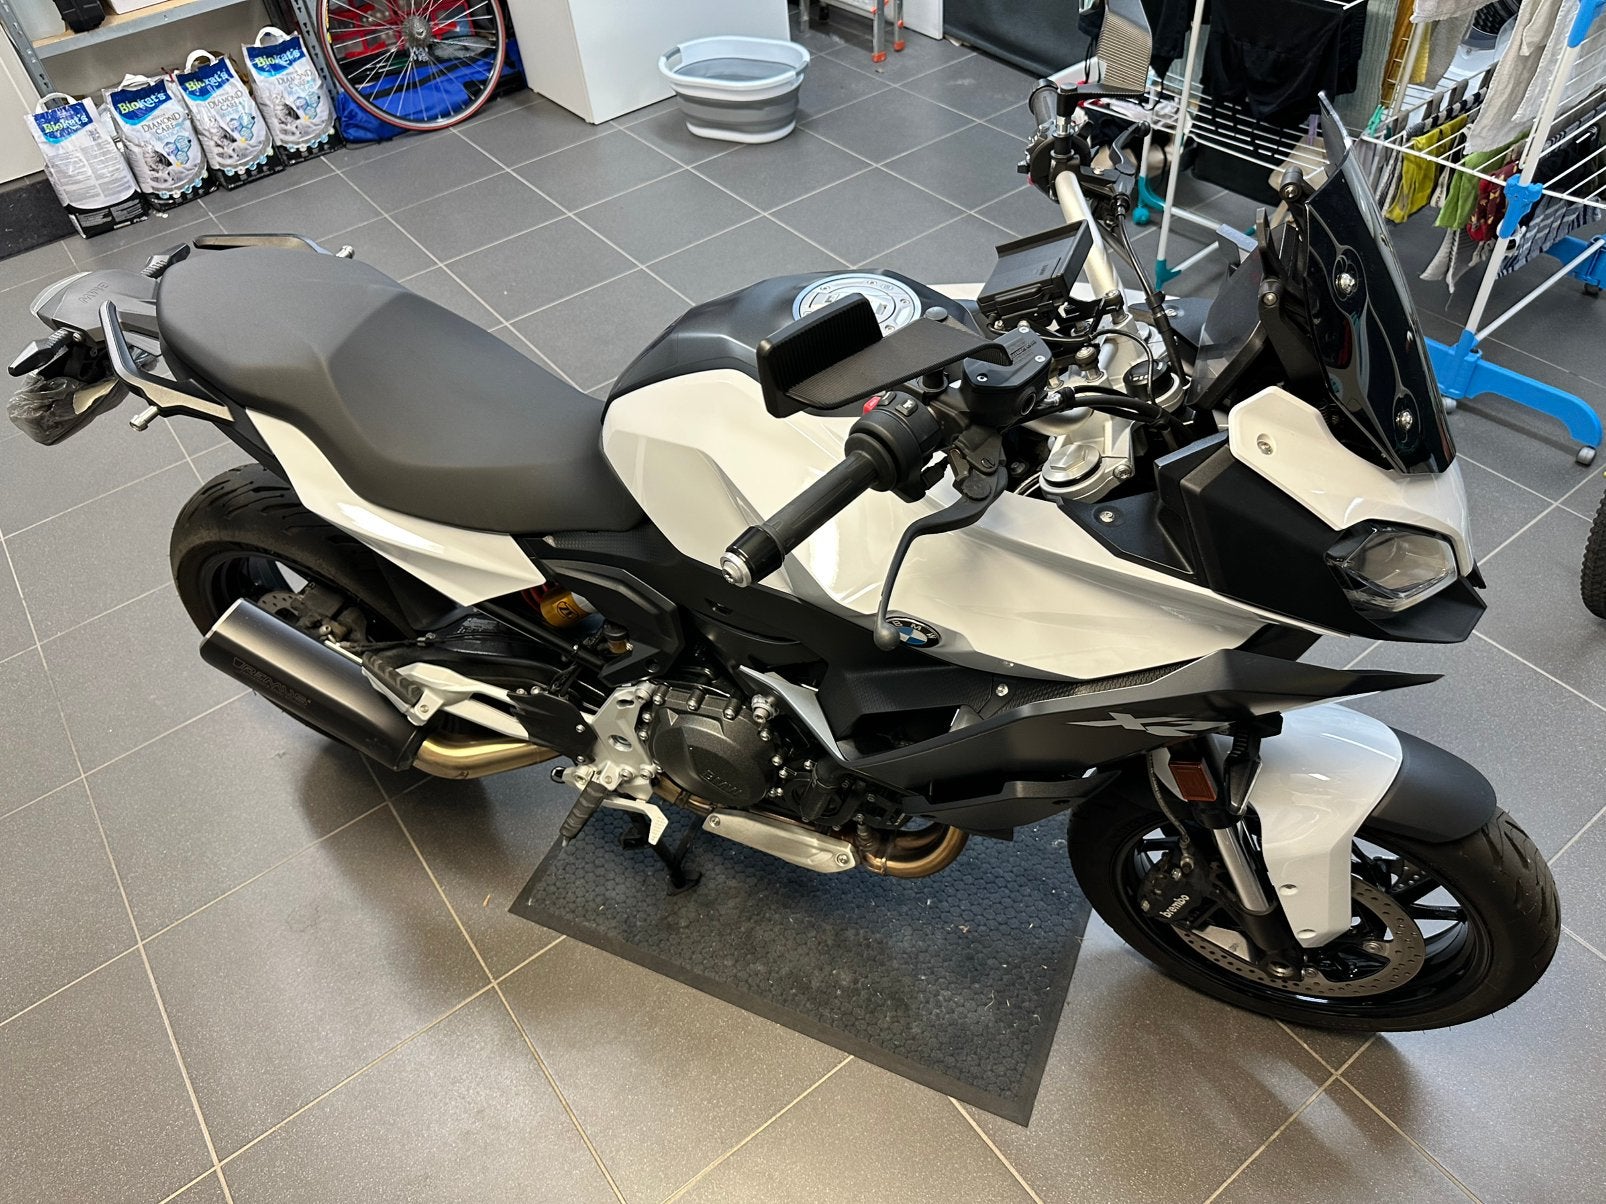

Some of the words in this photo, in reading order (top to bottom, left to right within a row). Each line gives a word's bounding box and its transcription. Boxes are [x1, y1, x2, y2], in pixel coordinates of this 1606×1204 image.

[117, 92, 167, 115] Biokat's
[207, 89, 243, 110] DIAMOND
[42, 114, 88, 133] Biokat's
[141, 112, 181, 133] DIAMOND
[155, 122, 175, 135] CARE
[892, 620, 937, 639] BMW
[1159, 894, 1190, 919] brembo
